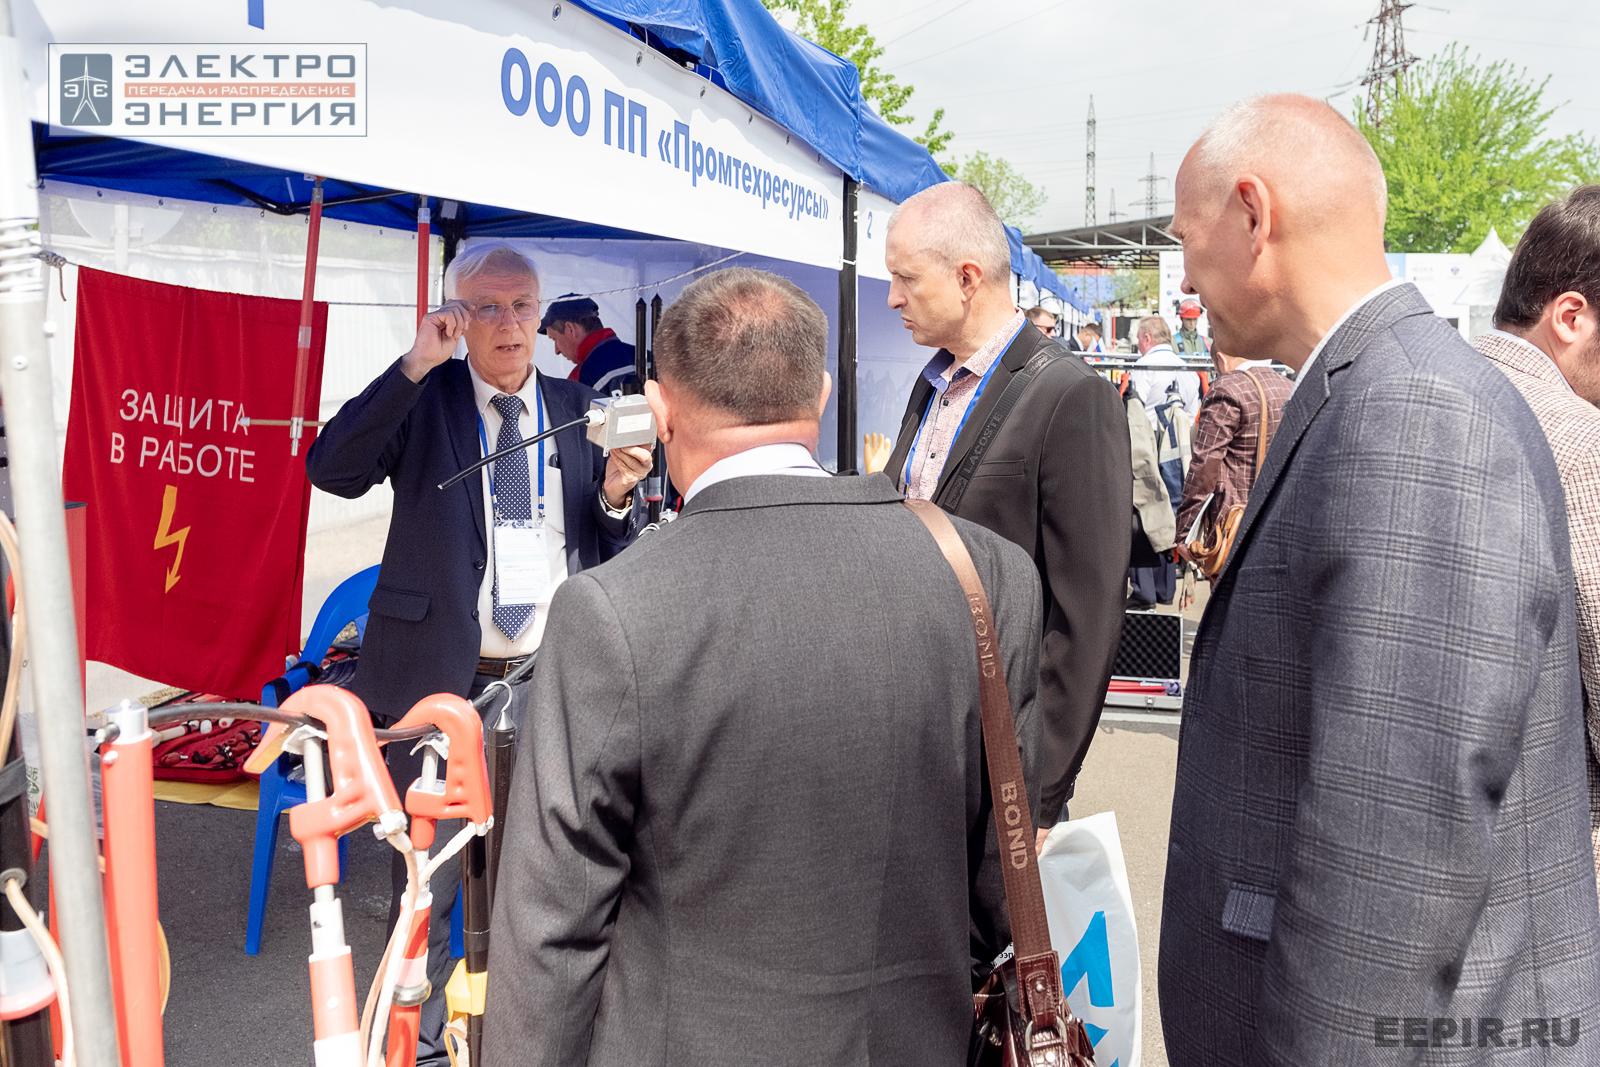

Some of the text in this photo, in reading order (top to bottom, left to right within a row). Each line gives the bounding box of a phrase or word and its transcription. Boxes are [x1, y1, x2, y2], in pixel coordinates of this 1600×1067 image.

[501, 47, 829, 221] ООО ПП «Промтехресурсы»
[119, 389, 249, 436] ЗАЩИТА
[110, 432, 255, 483] В РАБОТЕ
[963, 413, 1004, 475] LACOSTE
[1000, 781, 1028, 870] BOND
